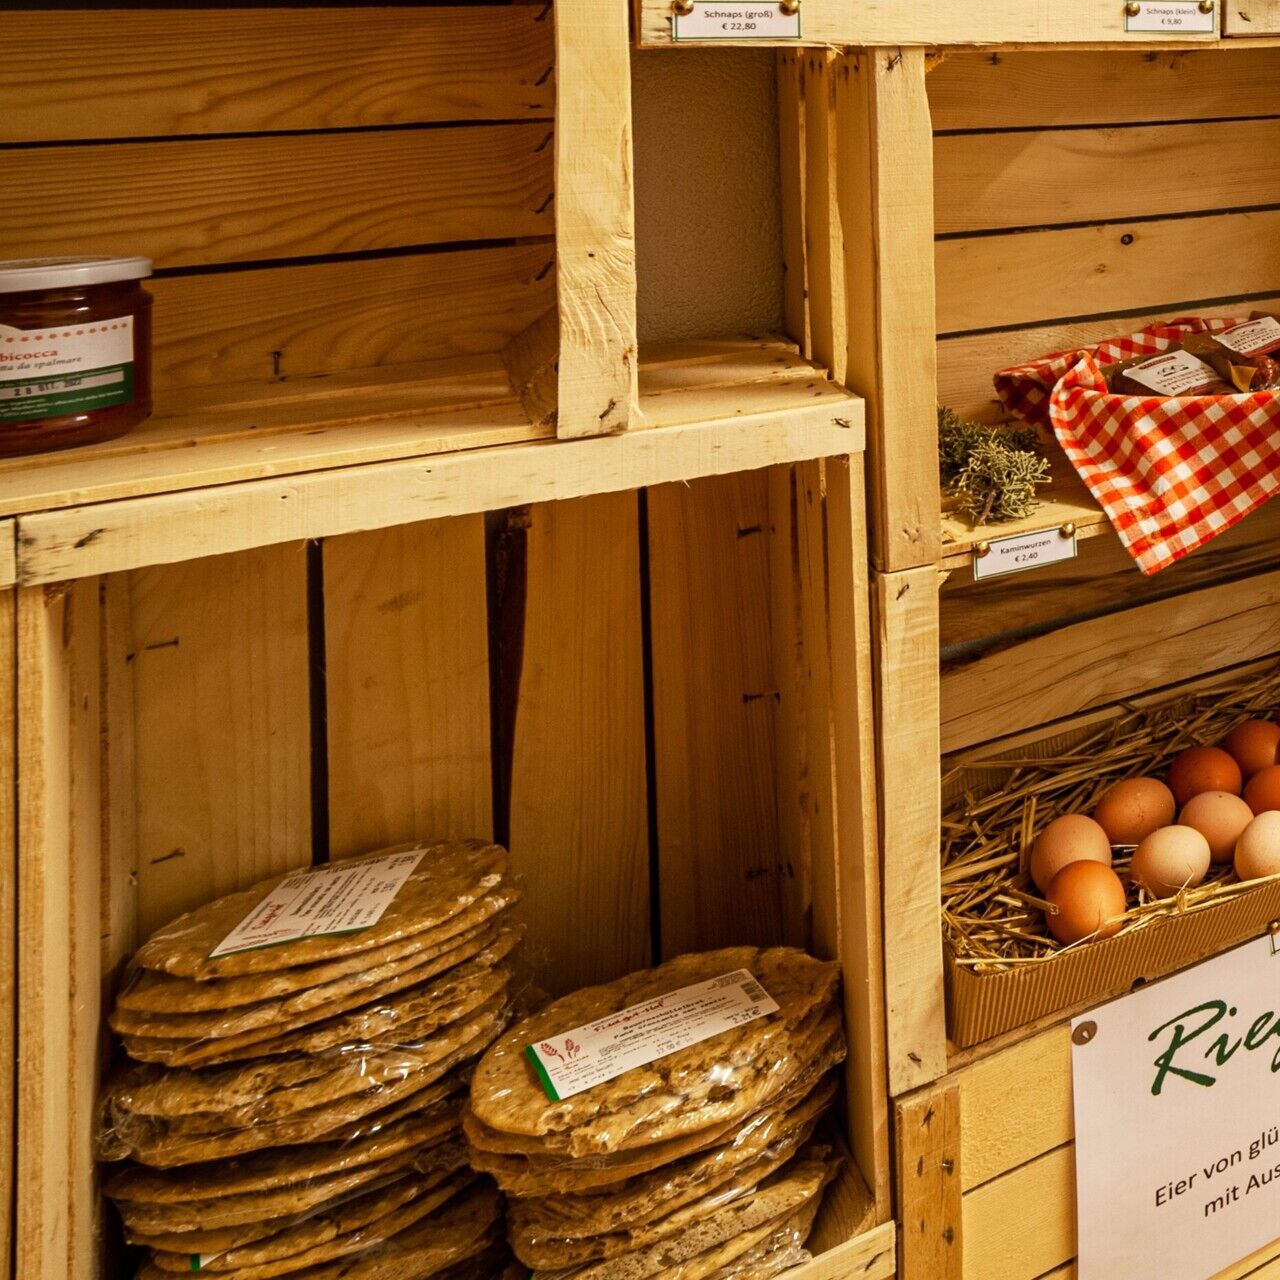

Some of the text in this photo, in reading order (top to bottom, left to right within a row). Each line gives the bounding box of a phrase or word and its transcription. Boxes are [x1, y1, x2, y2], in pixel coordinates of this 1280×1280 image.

[704, 10, 773, 19] Schnaps (groß)
[722, 22, 756, 31] € 22,80
[1000, 539, 1052, 554] Kaminwurzen
[1022, 552, 1039, 561] 2,40
[1155, 1173, 1198, 1207] Eier
[1203, 1150, 1242, 1180] von
[1204, 1186, 1240, 1218] mit
